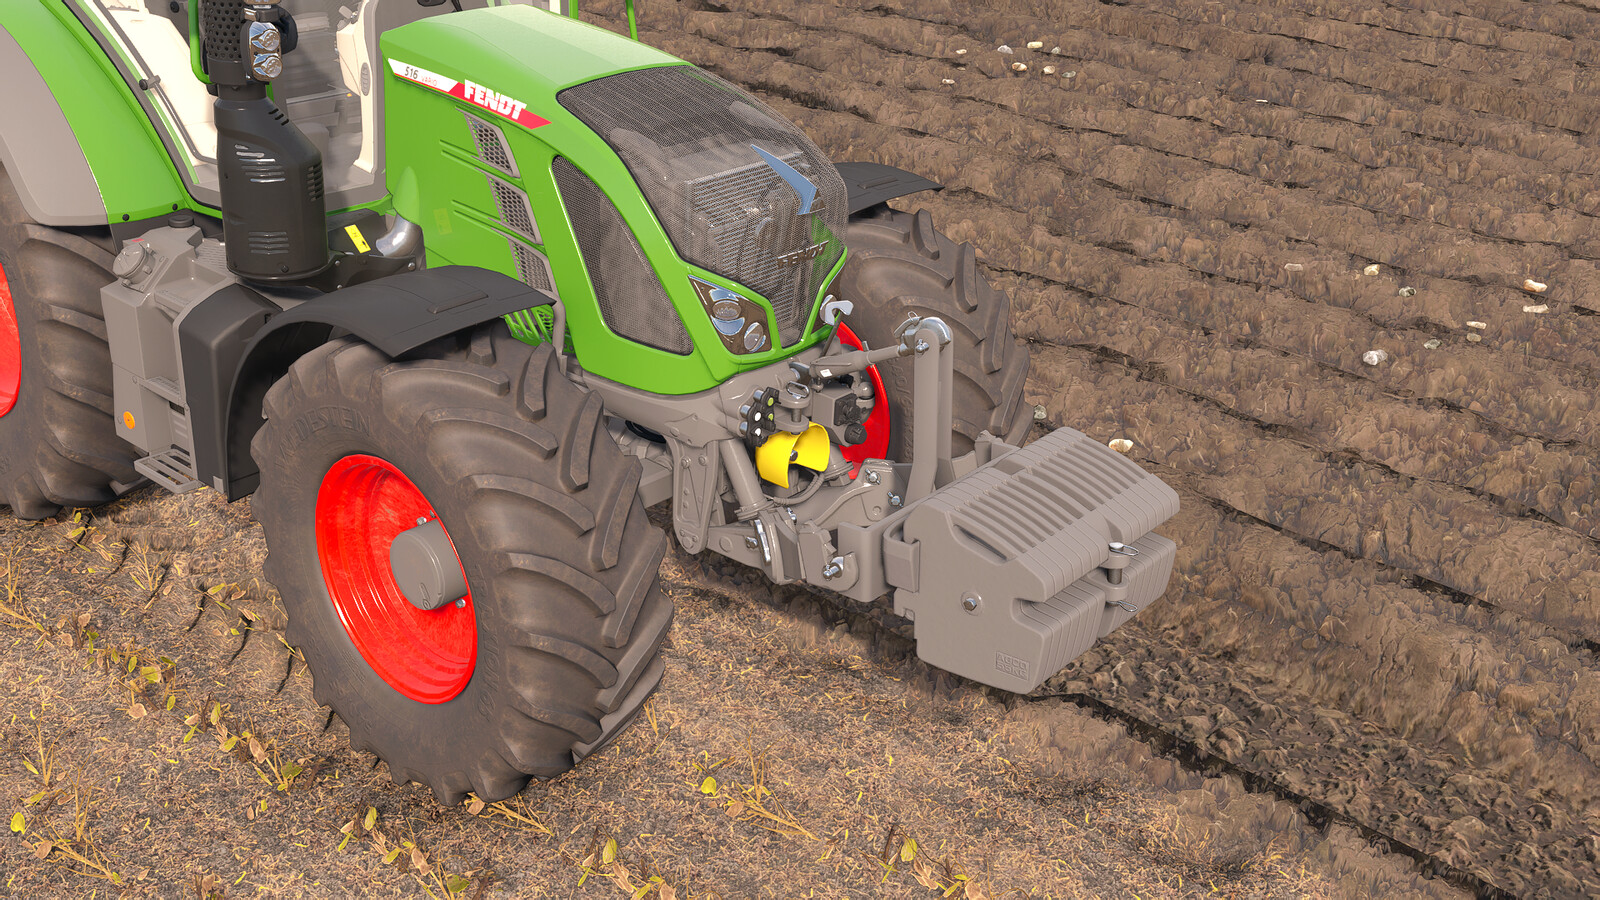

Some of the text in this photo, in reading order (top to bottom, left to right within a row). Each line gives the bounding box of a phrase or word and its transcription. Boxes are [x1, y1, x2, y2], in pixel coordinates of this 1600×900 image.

[404, 66, 438, 87] 516 VARIO
[464, 78, 527, 120] FENDT
